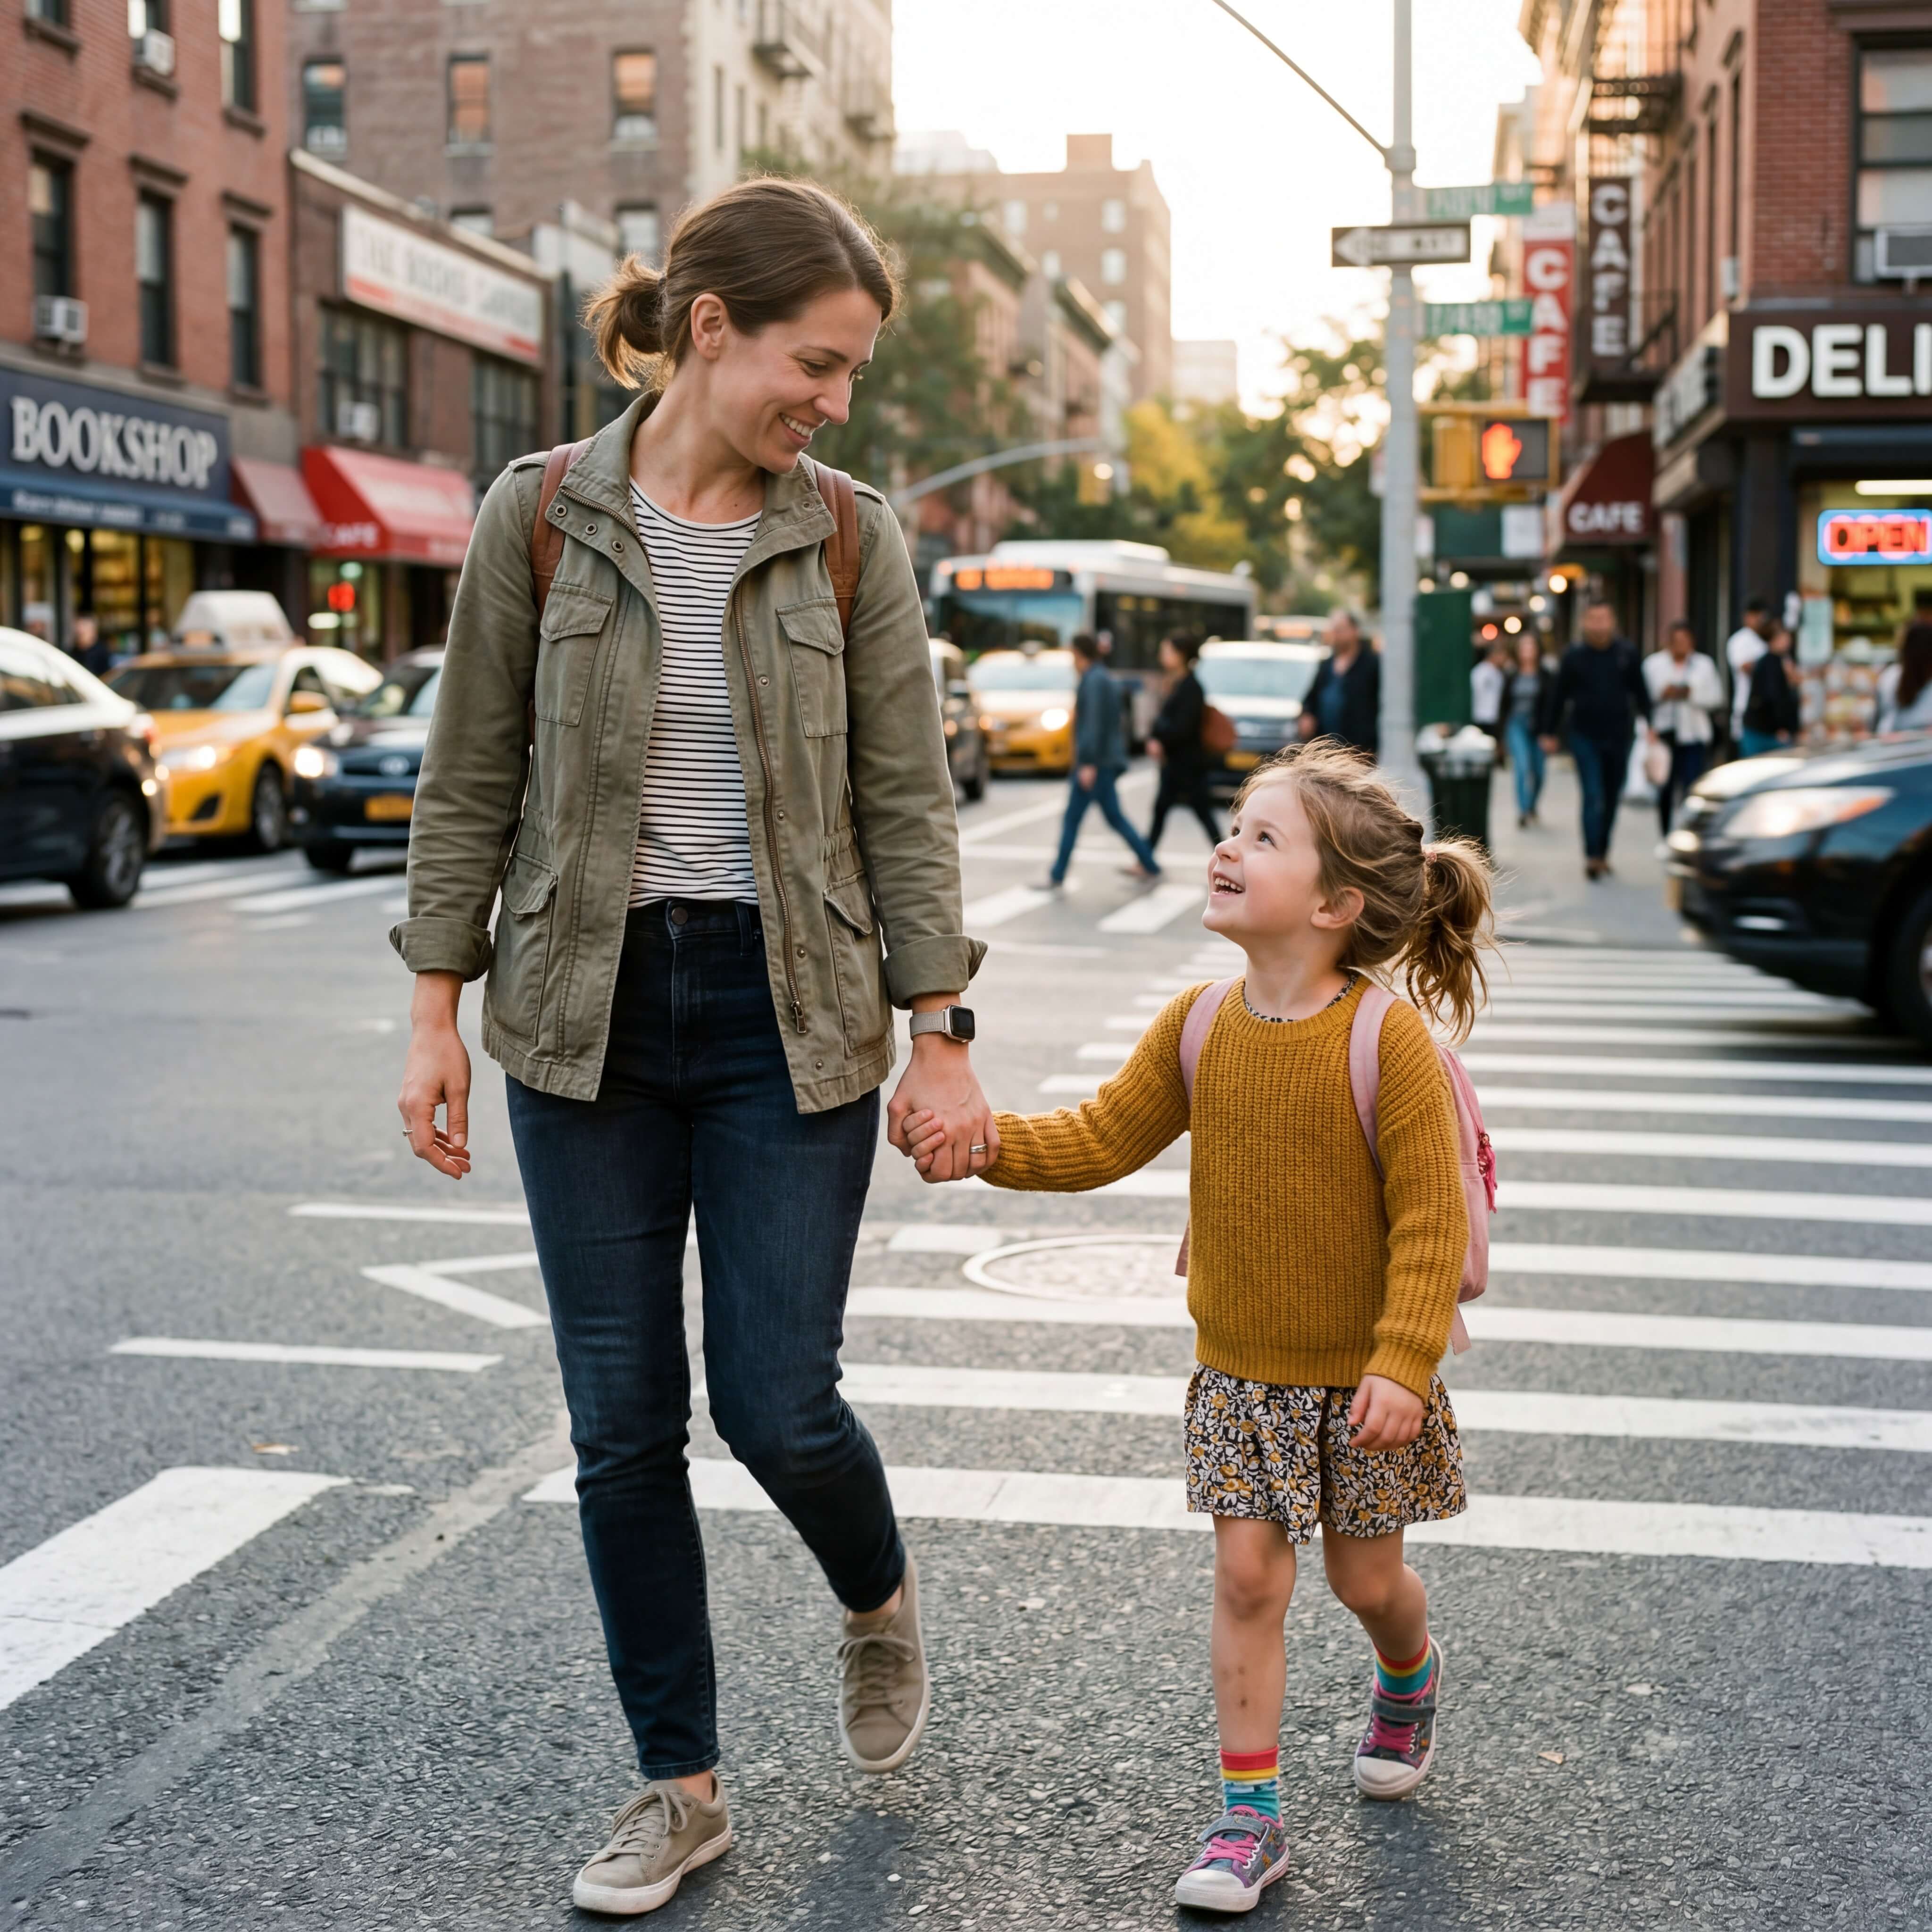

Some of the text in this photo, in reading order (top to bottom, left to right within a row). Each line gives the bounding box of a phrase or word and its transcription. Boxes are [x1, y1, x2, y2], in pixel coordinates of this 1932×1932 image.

[1591, 184, 1628, 357] CAFE
[1526, 248, 1569, 418] CAFE
[1752, 323, 1932, 399] DELI
[11, 395, 218, 489] BOOKSHOP
[1568, 500, 1643, 533] CAFE
[1824, 515, 1931, 560] OPEN
